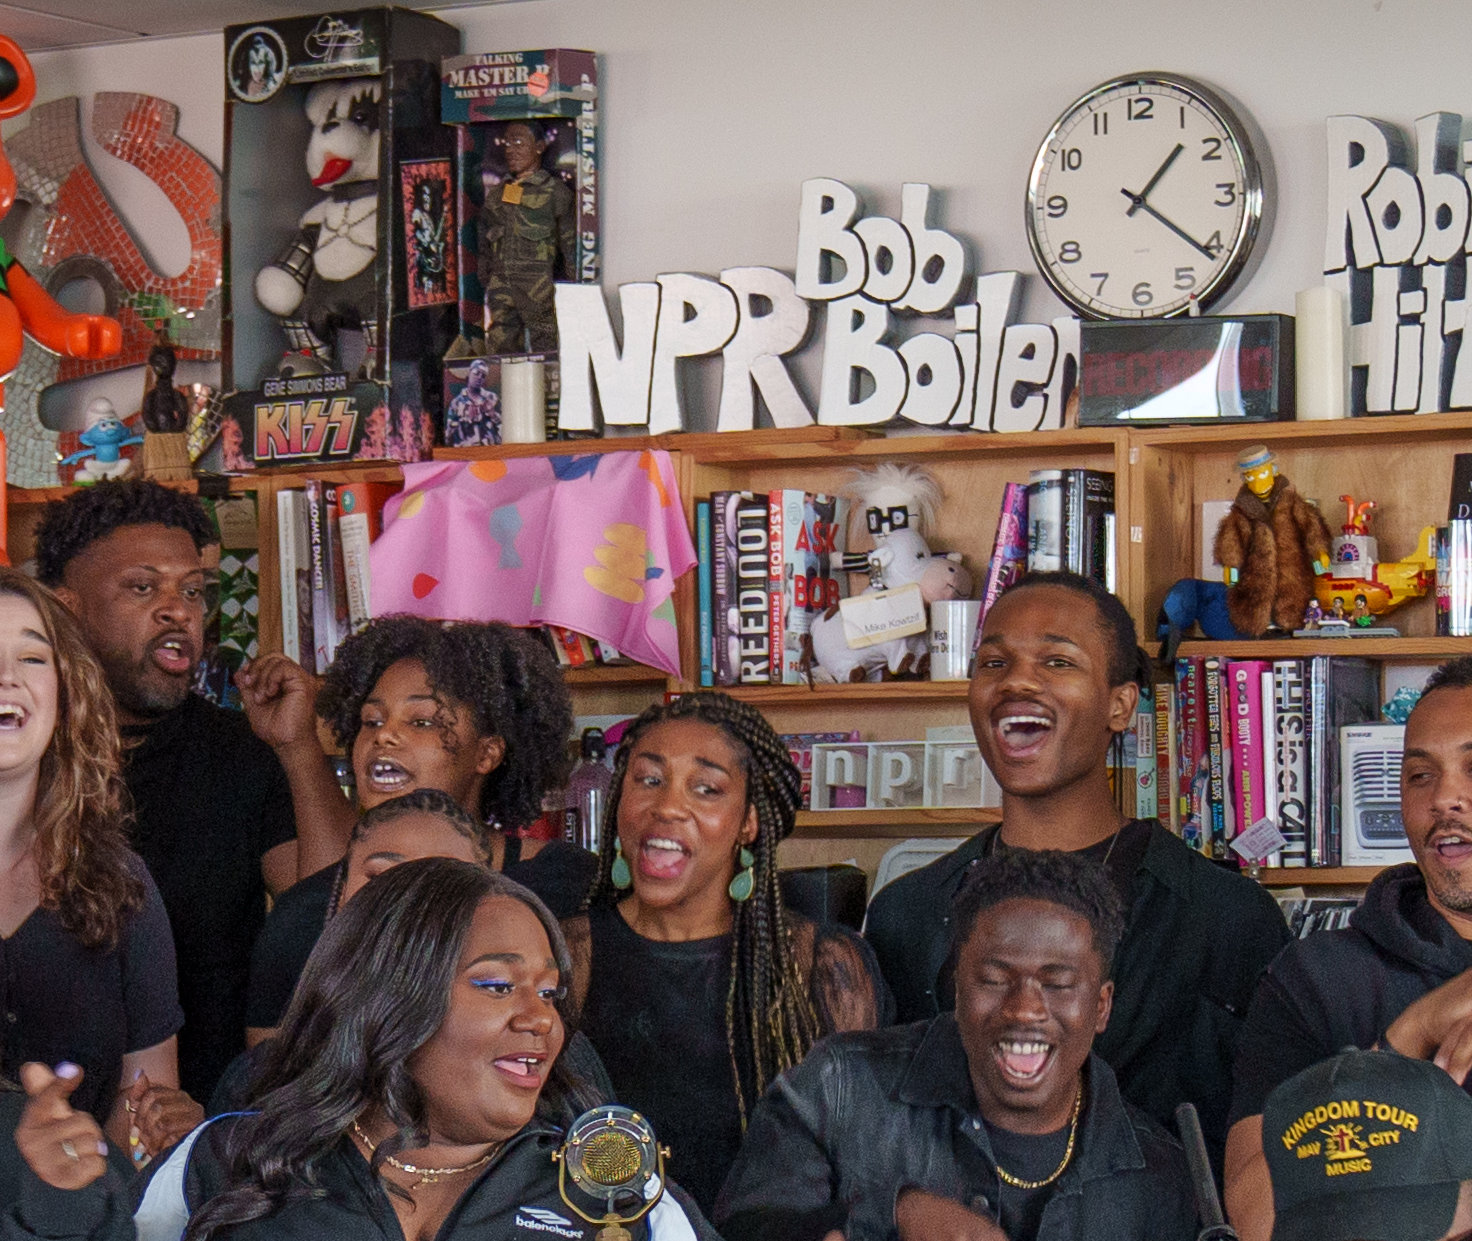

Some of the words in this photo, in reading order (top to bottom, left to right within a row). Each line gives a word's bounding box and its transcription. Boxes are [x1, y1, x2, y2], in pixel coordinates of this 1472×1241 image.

[475, 53, 523, 65] TALKING
[449, 66, 529, 88] MASTER
[1127, 98, 1154, 121] 12
[1092, 112, 1109, 136] 11
[582, 101, 597, 217] MASTER
[1060, 147, 1084, 172] 10
[1202, 138, 1222, 163] 2
[1047, 195, 1068, 218] 9
[1214, 182, 1236, 207] 3
[795, 177, 966, 316] Bob
[1059, 240, 1083, 263] 8
[1089, 273, 1111, 297] 7
[1174, 267, 1197, 290] 5
[1132, 281, 1154, 306] 6
[554, 266, 820, 435] NPR
[264, 380, 287, 397] GENE
[289, 378, 322, 395] SIMMONS
[323, 378, 346, 393] BEAR
[254, 397, 358, 460] KISS
[310, 503, 323, 544] COSMIC
[770, 503, 781, 538] ASK
[715, 524, 725, 563] CONSTANT
[795, 520, 840, 554] ASK
[313, 546, 323, 589] DANCER
[770, 541, 782, 576] BOB
[716, 564, 726, 595] SORROW
[794, 574, 841, 609] BOB
[738, 590, 769, 683] REED
[864, 623, 887, 634] Mike
[1155, 683, 1169, 707] MIKE
[1207, 671, 1219, 713] FORGOTTEN
[1235, 669, 1249, 715] GOOD
[1275, 661, 1304, 735] THIS
[1156, 711, 1170, 755] DOUGHTY
[1237, 718, 1251, 745] BOOTY
[1276, 741, 1303, 765] is
[828, 748, 965, 802] npr
[1241, 770, 1251, 792] ANN
[1277, 770, 1298, 793] a
[1211, 780, 1223, 800] FLOPS
[1278, 797, 1305, 867] CALL
[1282, 1100, 1361, 1150] KINGDOM
[1363, 1101, 1420, 1132] TOUR
[1368, 1131, 1401, 1146] CITY
[1325, 1158, 1373, 1176] MUSIC
